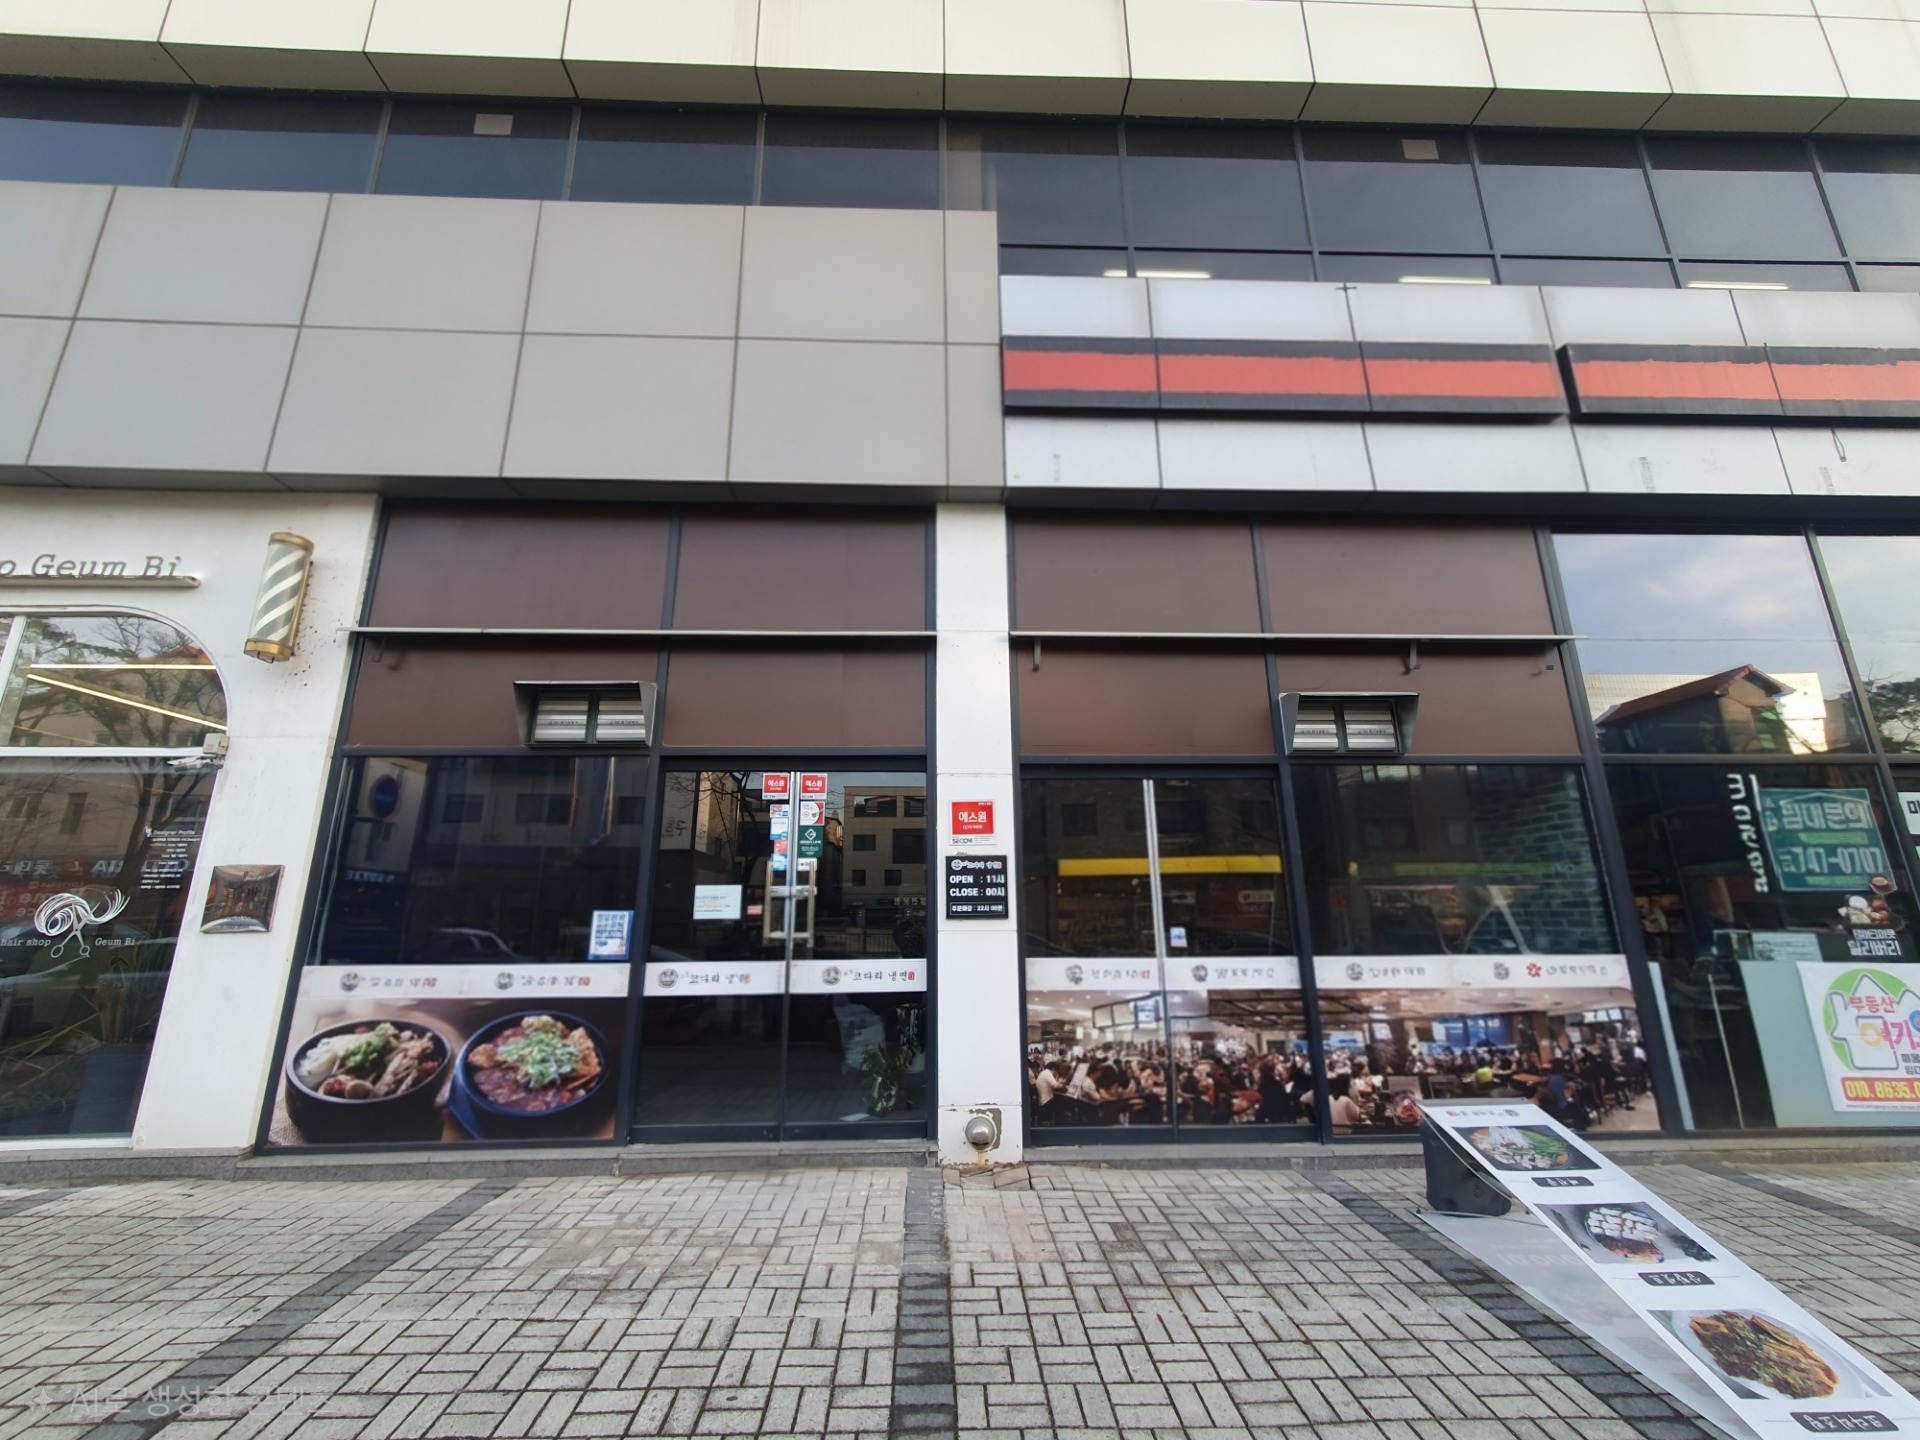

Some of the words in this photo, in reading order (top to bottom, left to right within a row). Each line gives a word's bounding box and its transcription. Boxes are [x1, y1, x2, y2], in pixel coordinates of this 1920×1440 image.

[31, 554, 127, 577] Geum
[143, 556, 182, 577] Bi
[958, 811, 987, 823] 에스원
[950, 875, 974, 884] OPEN
[986, 874, 1005, 884] 11시
[950, 888, 978, 896] CLOSE
[986, 887, 1005, 896] 00시
[0, 937, 24, 946] hair
[26, 937, 52, 947] shop
[95, 937, 122, 946] Geum
[852, 970, 883, 981] 코다리
[888, 970, 907, 982] 냉면
[1848, 994, 1896, 1014] 부동산
